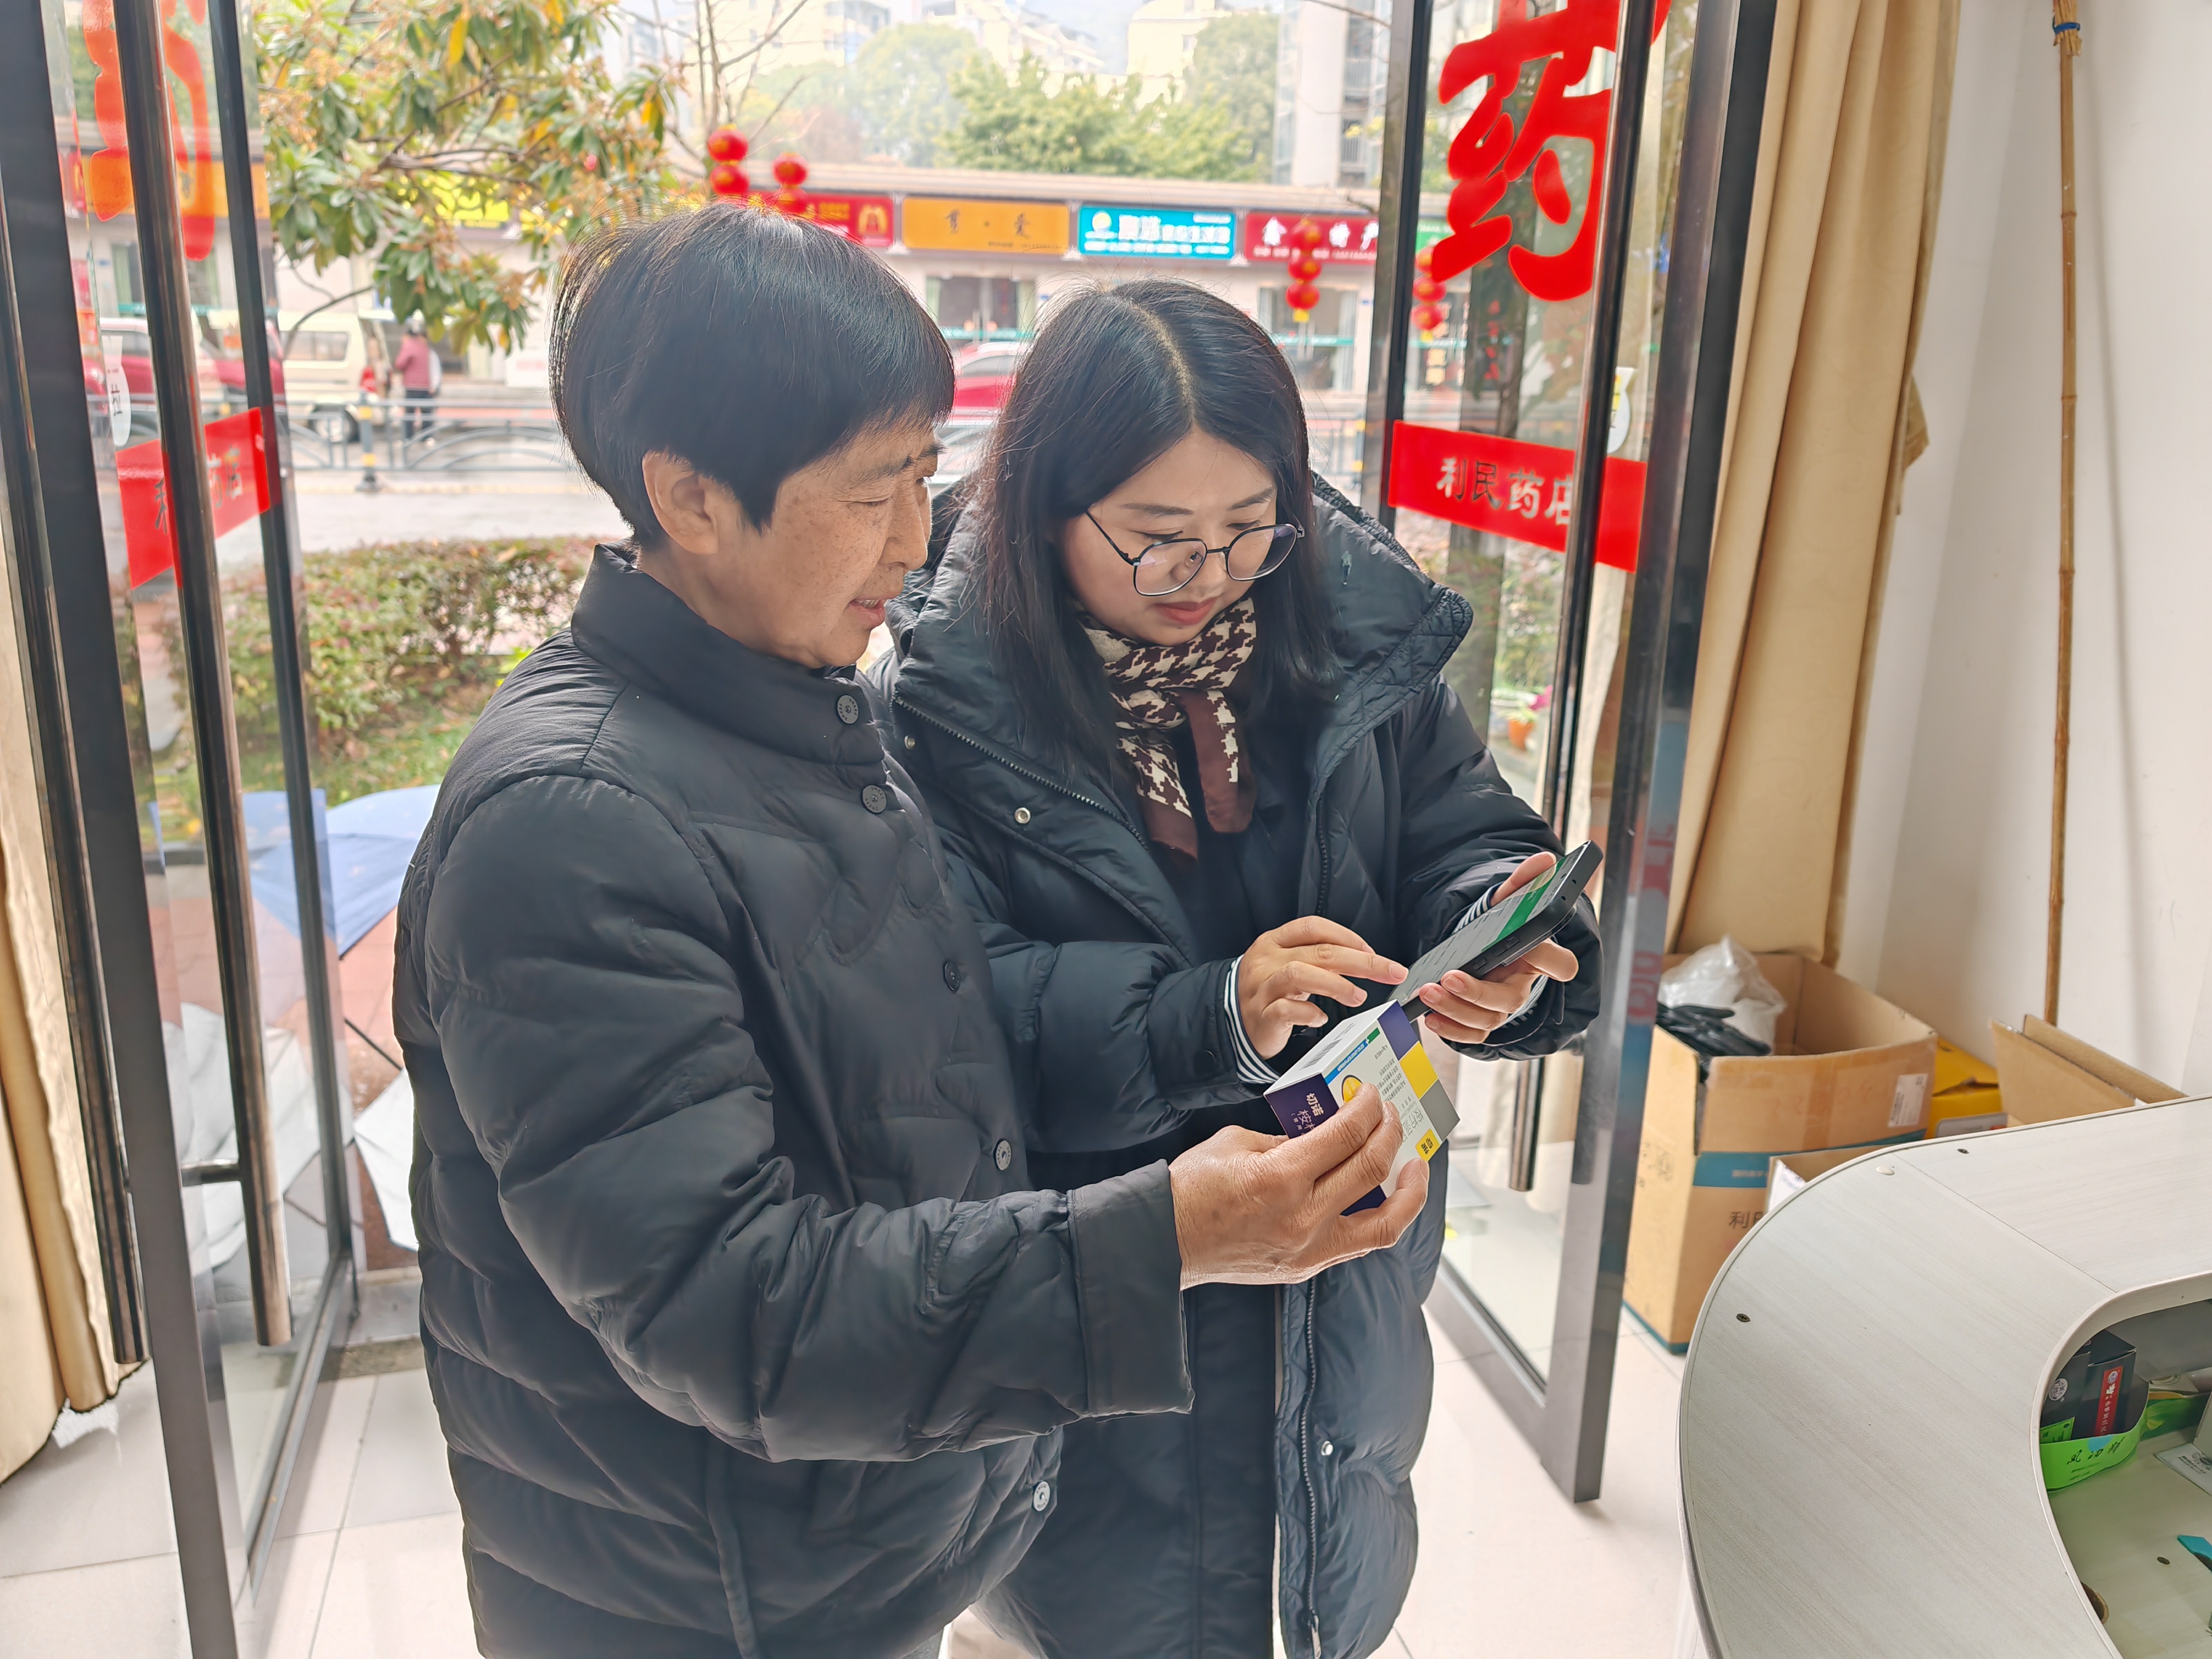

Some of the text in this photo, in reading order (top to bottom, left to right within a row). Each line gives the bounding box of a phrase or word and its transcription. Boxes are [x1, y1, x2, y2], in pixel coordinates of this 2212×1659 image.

[1431, 0, 1672, 302] 药
[1436, 458, 1574, 525] 利民药店
[1306, 1093, 1324, 1116] 切诺
[1421, 1137, 1434, 1155] 切诺
